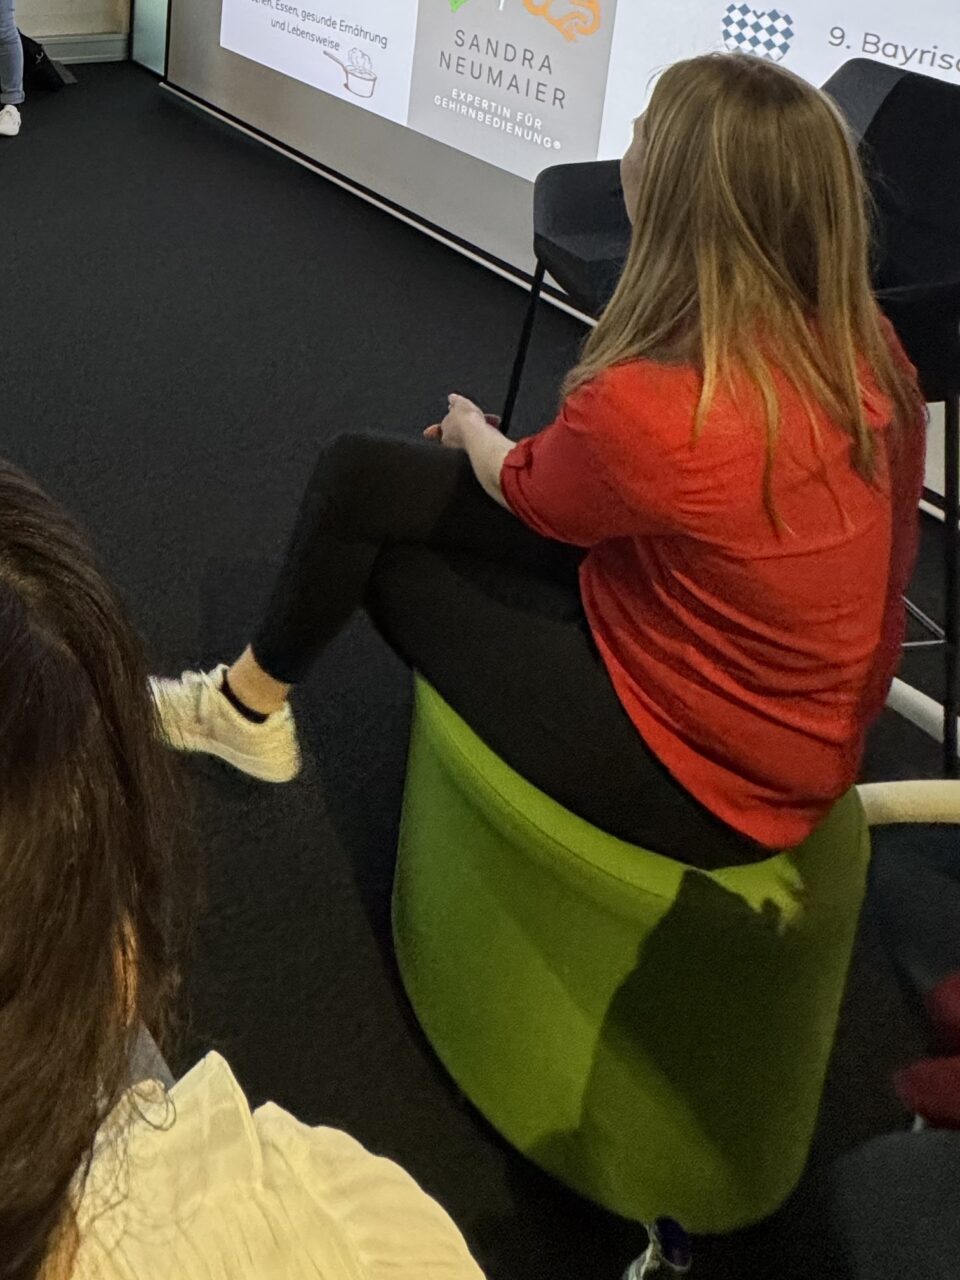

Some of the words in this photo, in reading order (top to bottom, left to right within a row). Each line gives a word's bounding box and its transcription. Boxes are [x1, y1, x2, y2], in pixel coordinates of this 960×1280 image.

[271, 19, 286, 32] und
[286, 21, 340, 51] Lebensweise
[301, 9, 338, 31] gesunde
[339, 19, 388, 50] Ernährung
[828, 26, 851, 49] 9.
[454, 29, 553, 75] SANDRA
[439, 51, 566, 109] NEUMAIER
[451, 88, 511, 119] EXPERTIN
[516, 111, 542, 131] FÜR
